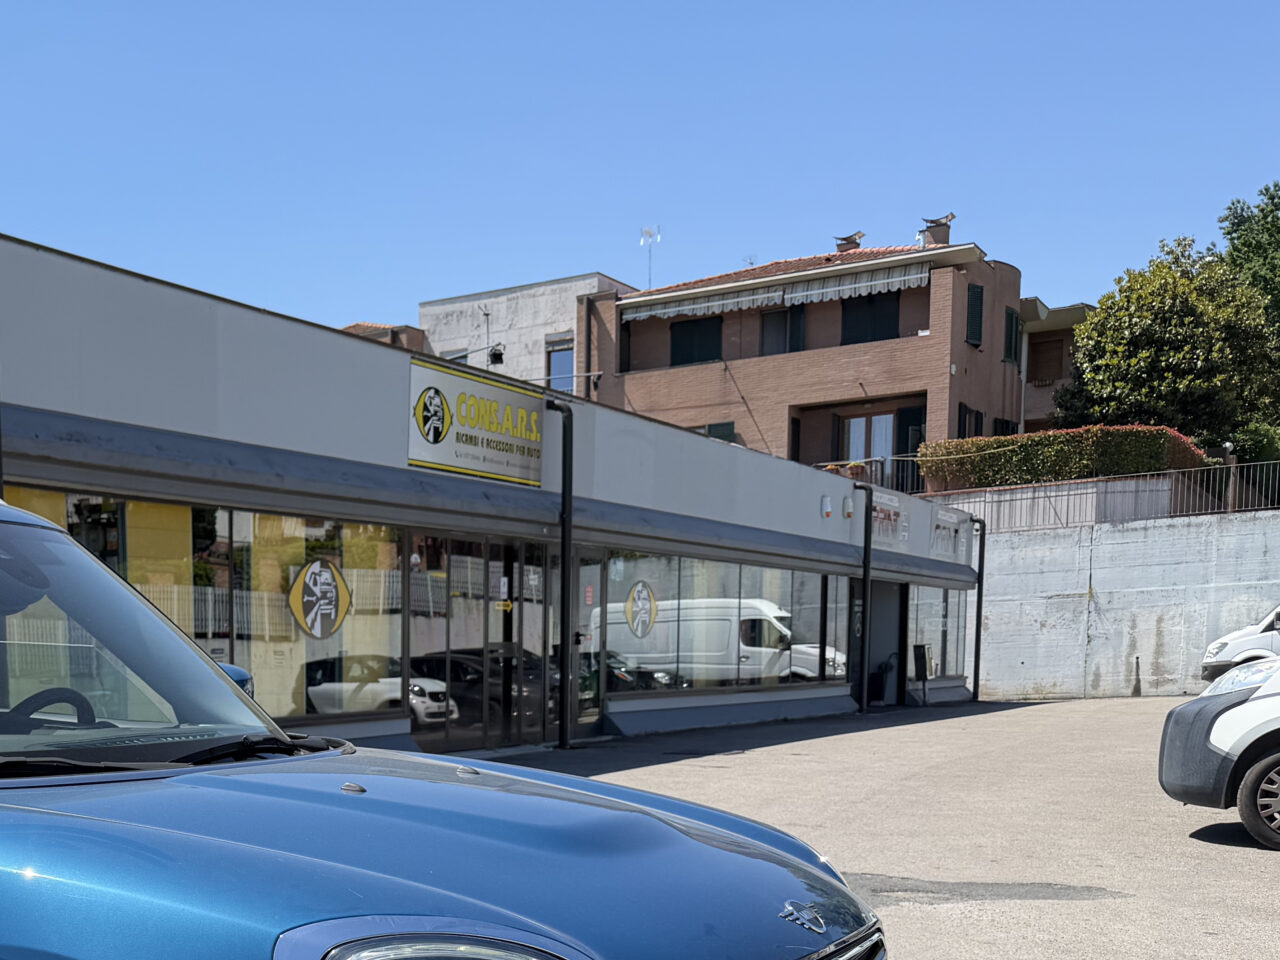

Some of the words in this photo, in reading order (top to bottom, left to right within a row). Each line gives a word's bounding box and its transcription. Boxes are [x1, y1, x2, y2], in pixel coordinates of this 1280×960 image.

[456, 392, 541, 442] CONS.A.R.S.
[455, 431, 480, 448] RICAMBI
[486, 437, 515, 454] ACCESSORI
[516, 444, 526, 456] PER
